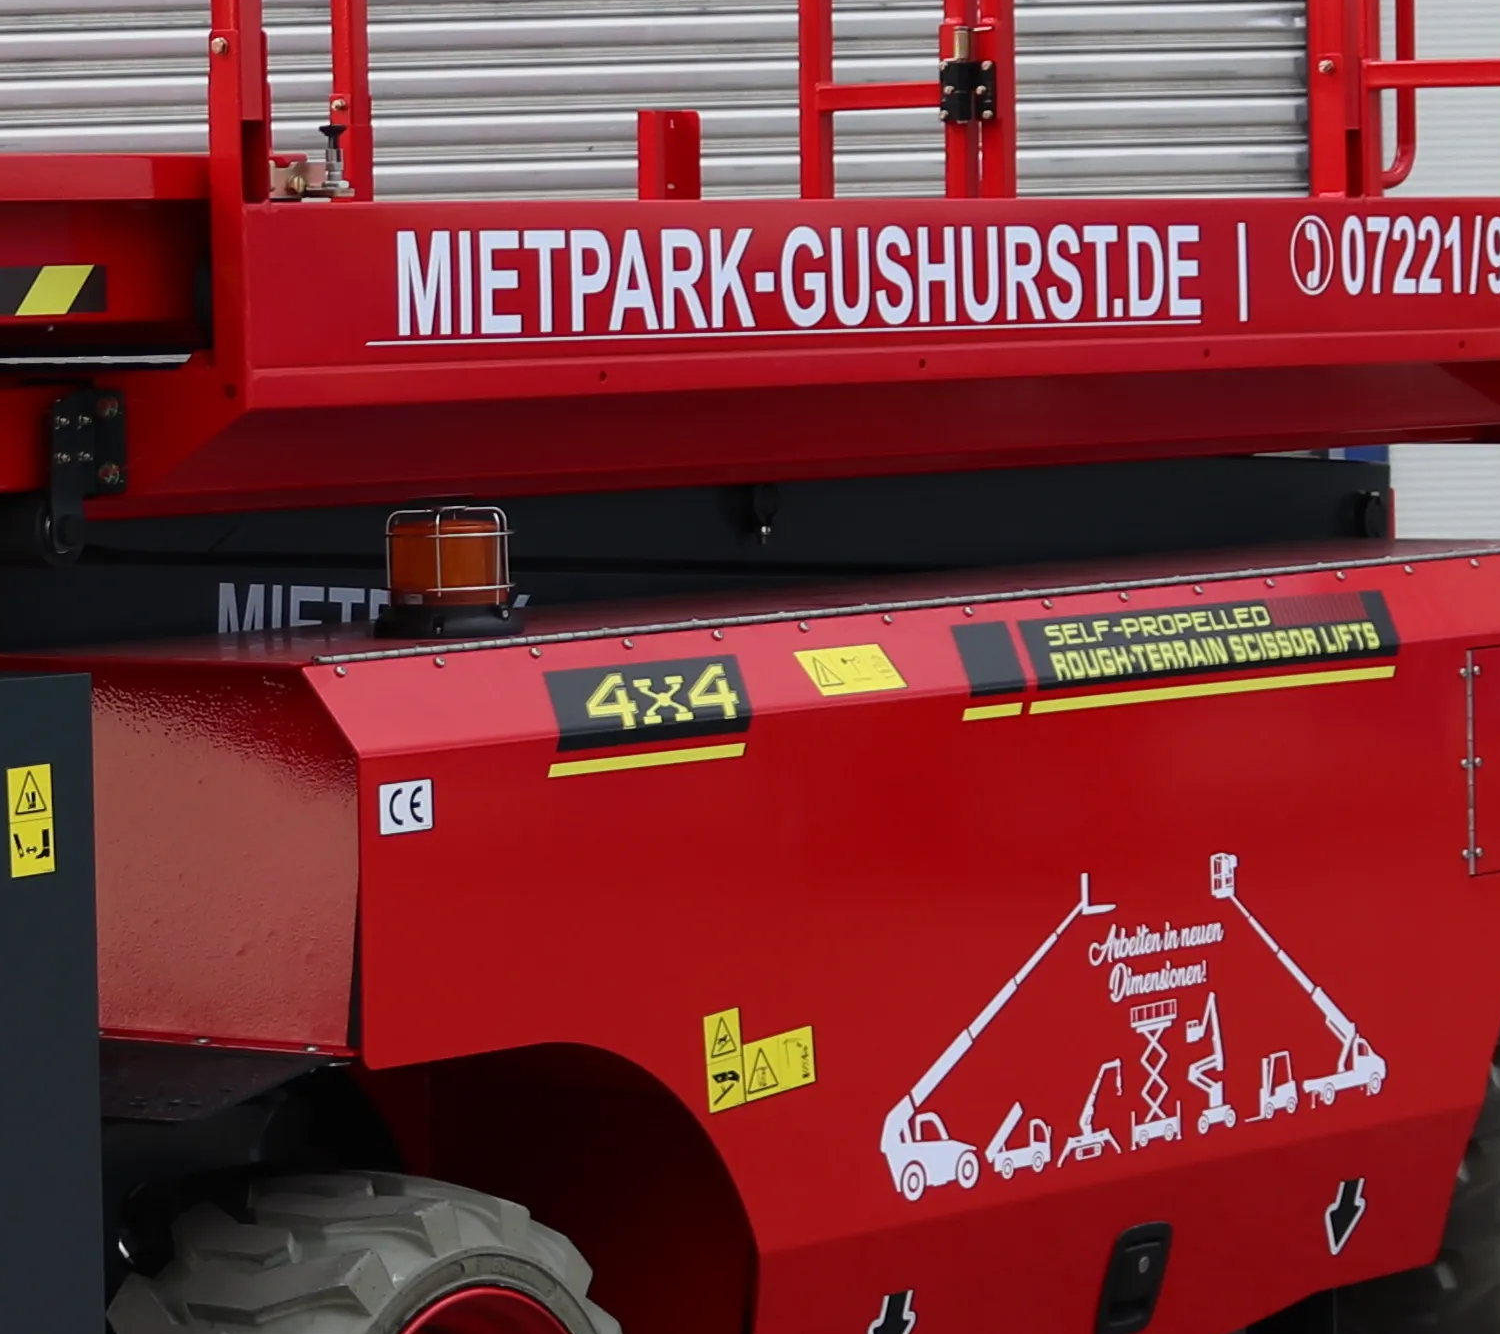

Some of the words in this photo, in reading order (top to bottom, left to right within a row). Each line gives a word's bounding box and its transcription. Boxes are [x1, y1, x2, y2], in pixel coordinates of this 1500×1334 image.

[396, 225, 1200, 336] MIETPARK-GUSHURST.DE
[1044, 605, 1271, 646] SELF-PROPELLED
[1050, 636, 1230, 682] ROUGH-TERRAIN
[1228, 627, 1322, 663] SCISSOR
[1319, 621, 1381, 654] LIFTS
[389, 786, 424, 826] CE
[1088, 923, 1163, 966] Arbeiten
[1164, 921, 1180, 950] in
[1181, 922, 1224, 947] neuen
[1109, 959, 1207, 1003] Dimensionen!
